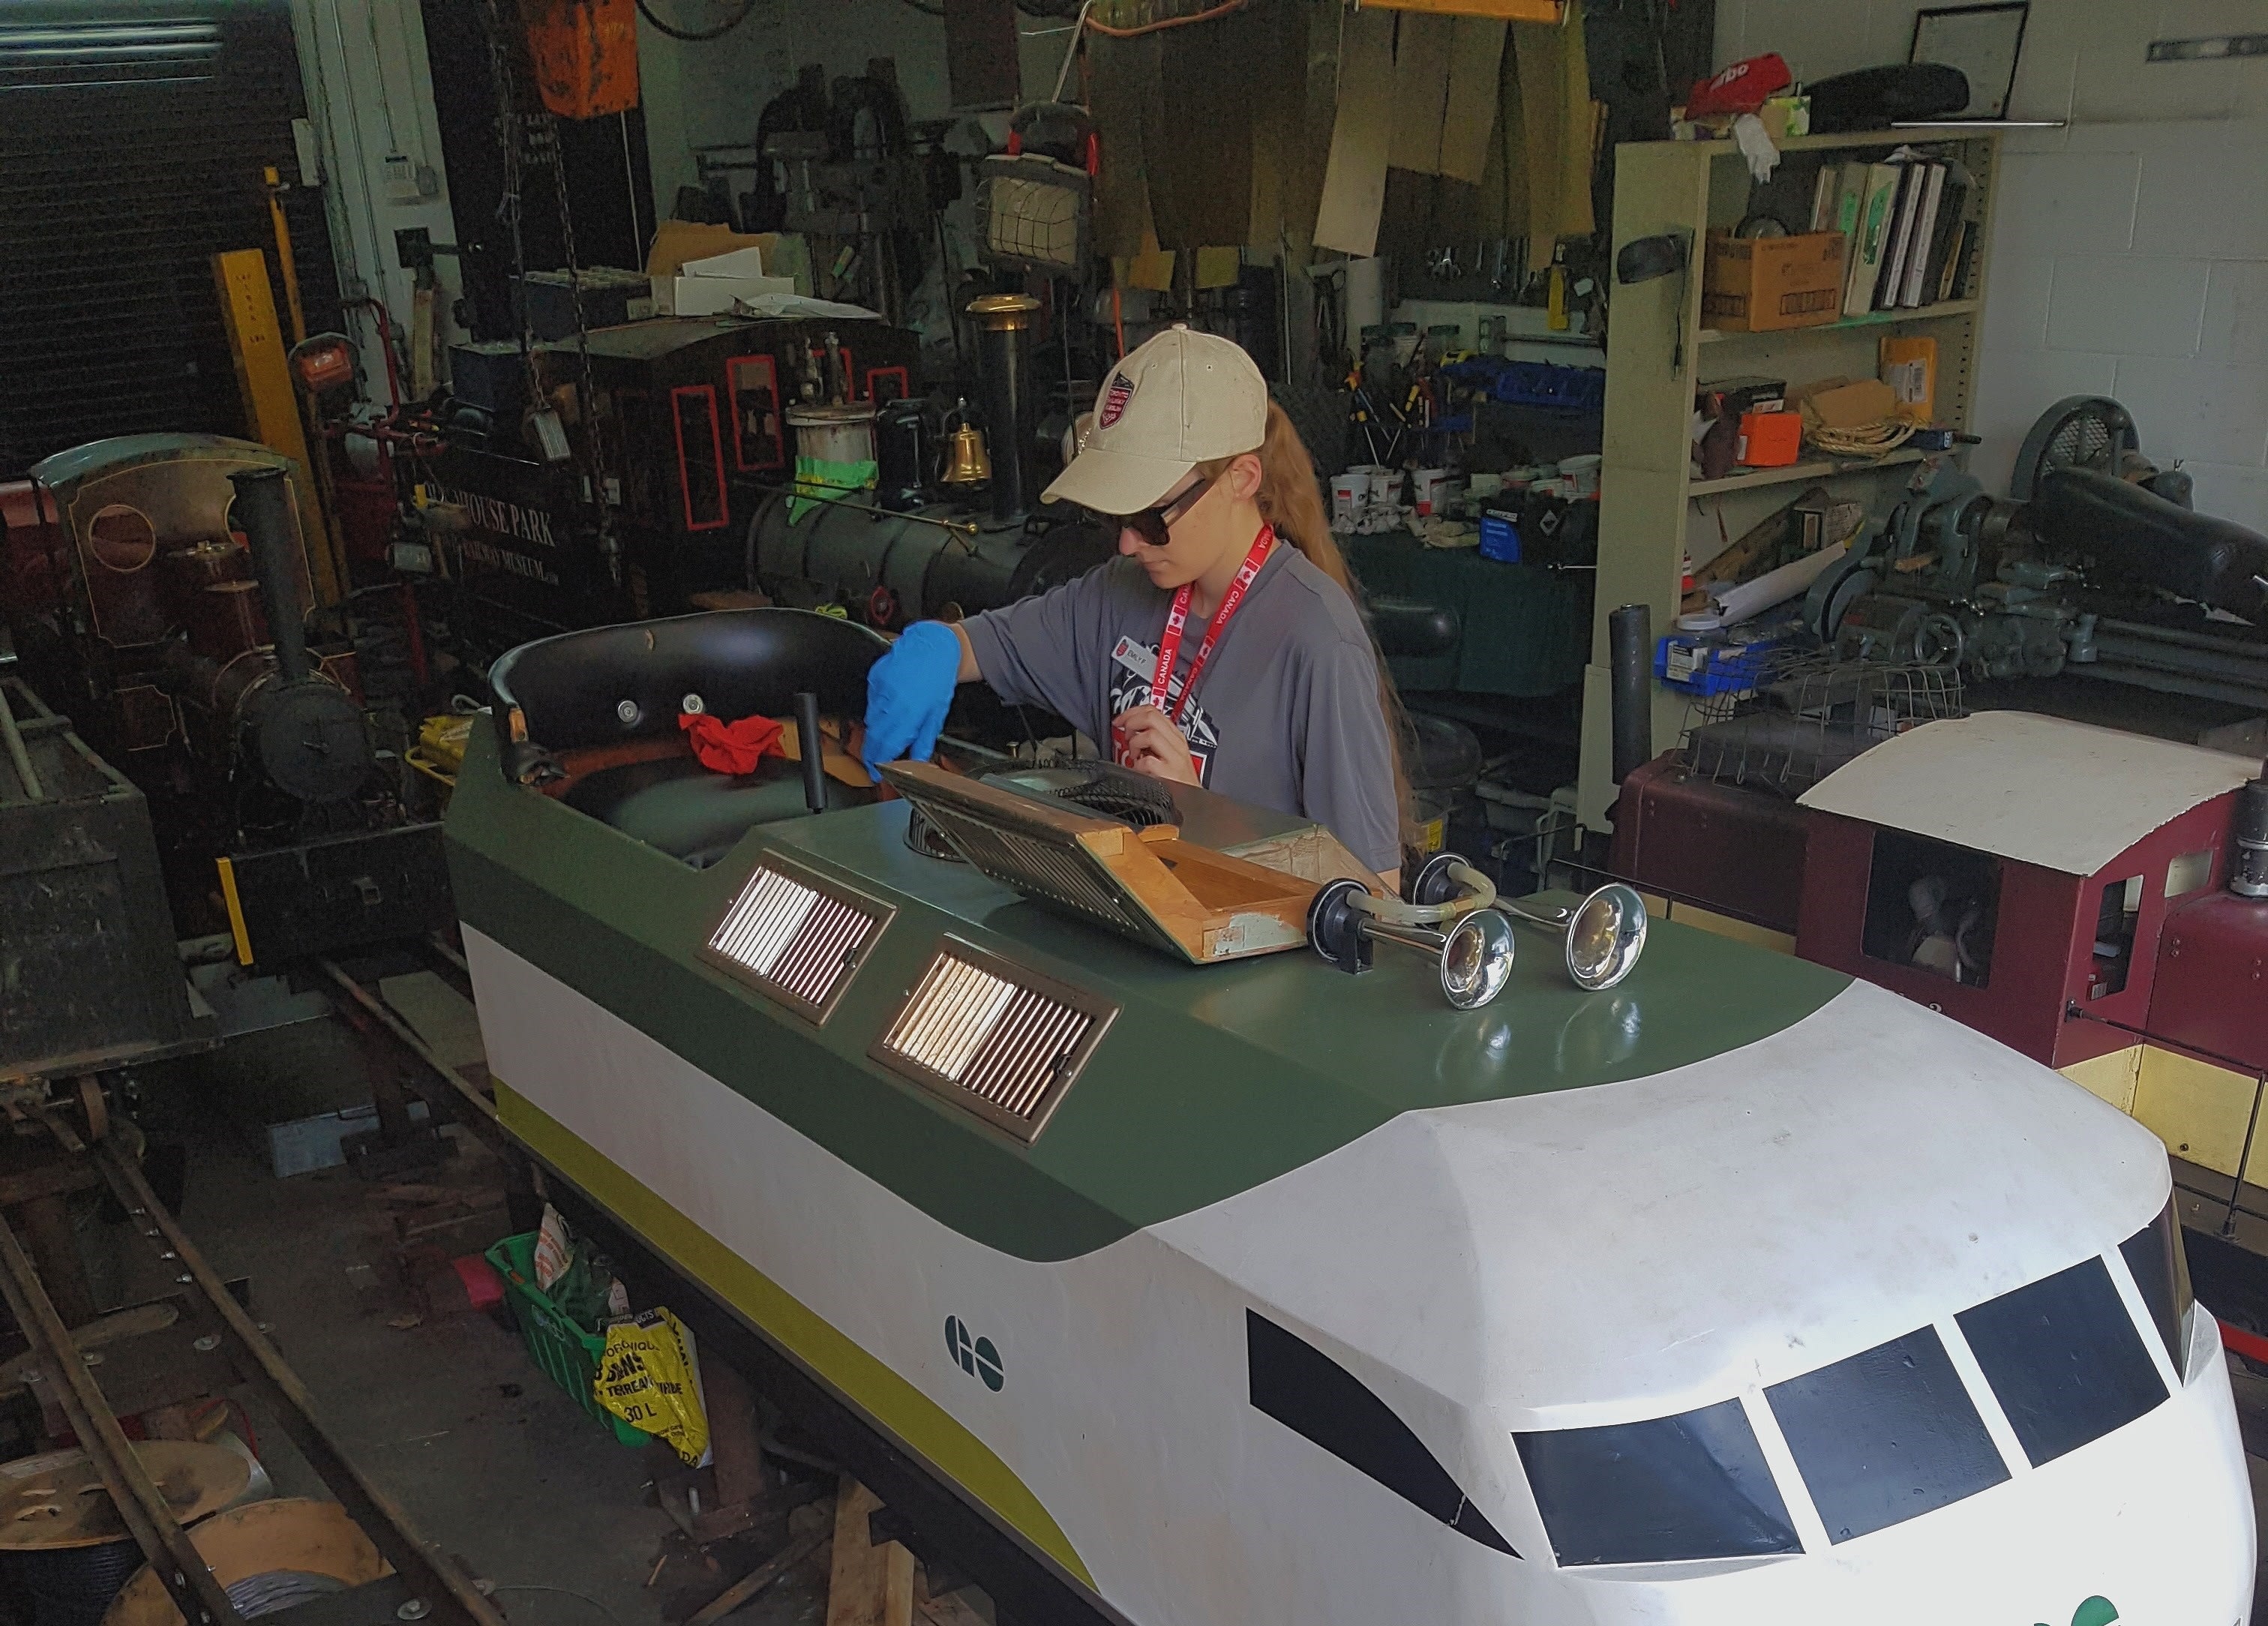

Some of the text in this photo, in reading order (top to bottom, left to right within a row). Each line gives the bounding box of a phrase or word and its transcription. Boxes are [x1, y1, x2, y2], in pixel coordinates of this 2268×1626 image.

[508, 504, 556, 548] PARK
[1216, 590, 1240, 626] CANADA
[1158, 648, 1173, 685] CANADA
[623, 1402, 658, 1423] 30 L
